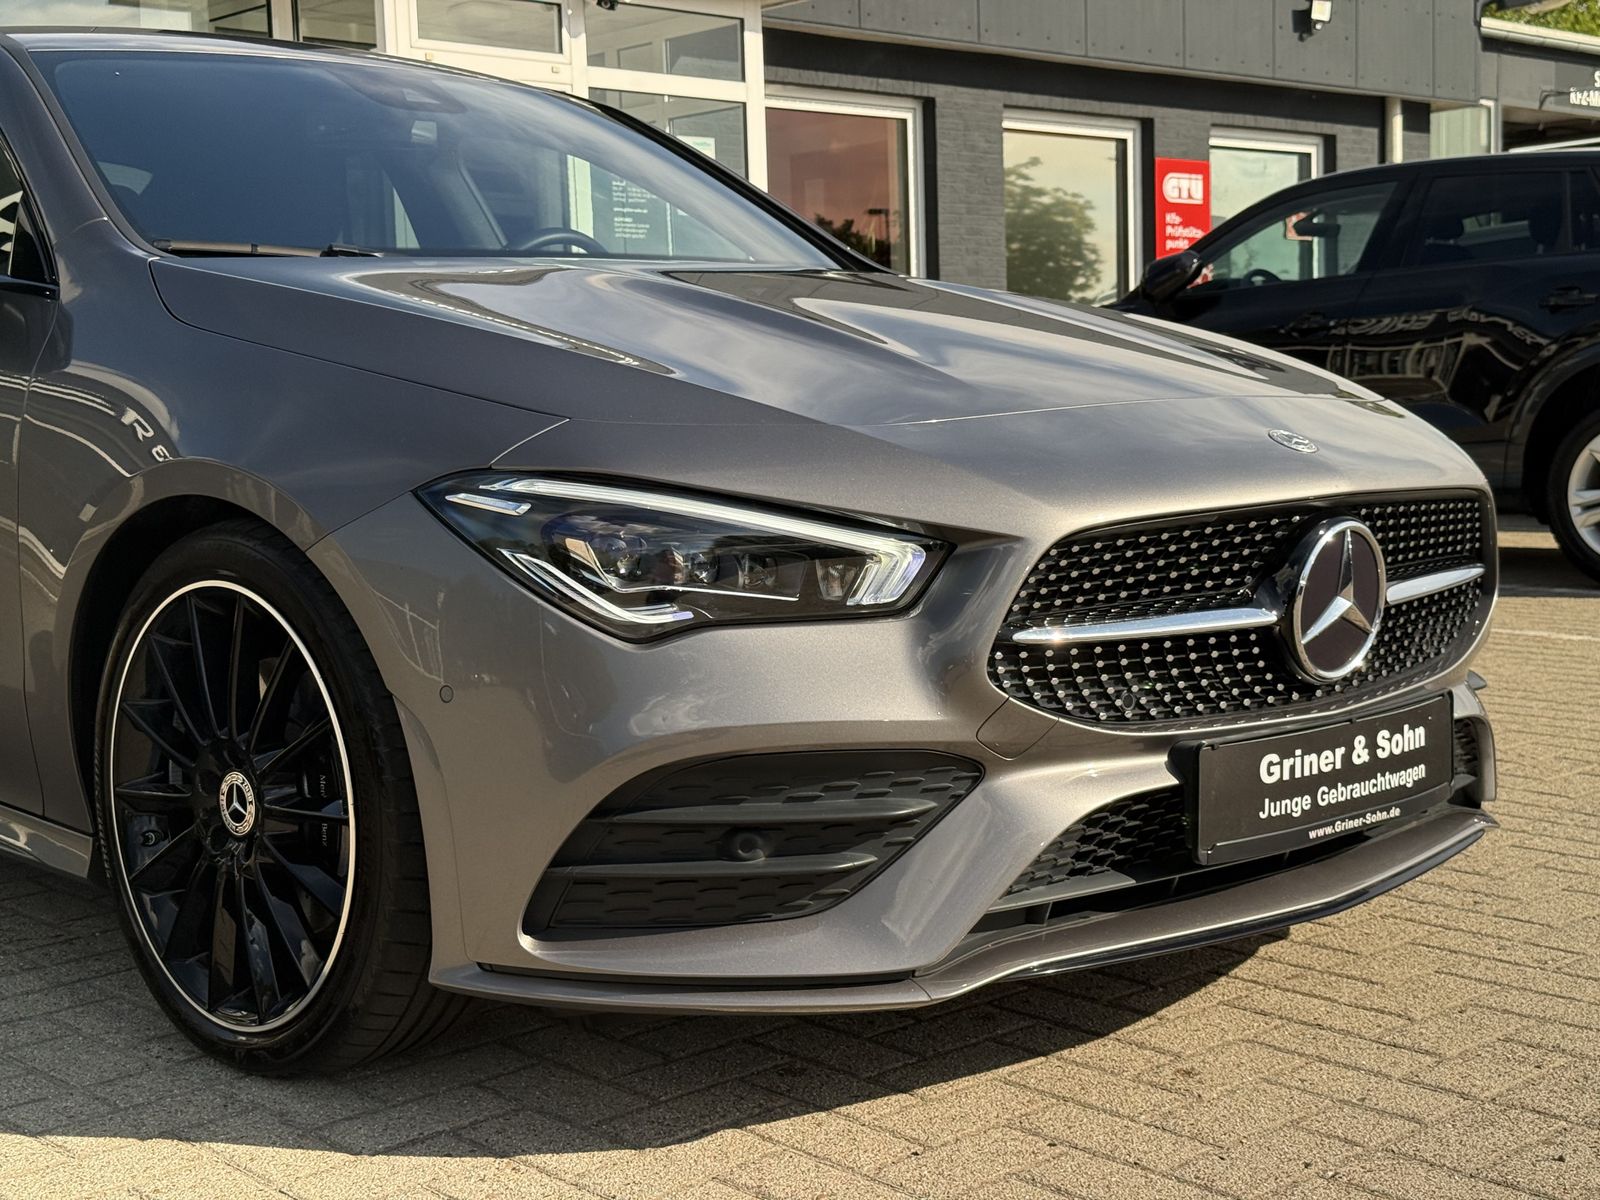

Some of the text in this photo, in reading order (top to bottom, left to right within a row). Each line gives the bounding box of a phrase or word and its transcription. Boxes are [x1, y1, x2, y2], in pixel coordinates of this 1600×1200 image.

[1259, 723, 1426, 784] Griner & Sohn
[1259, 763, 1426, 819] Junge Gebrauchtwagen
[1308, 806, 1401, 839] www.Griner-Sohn.de
